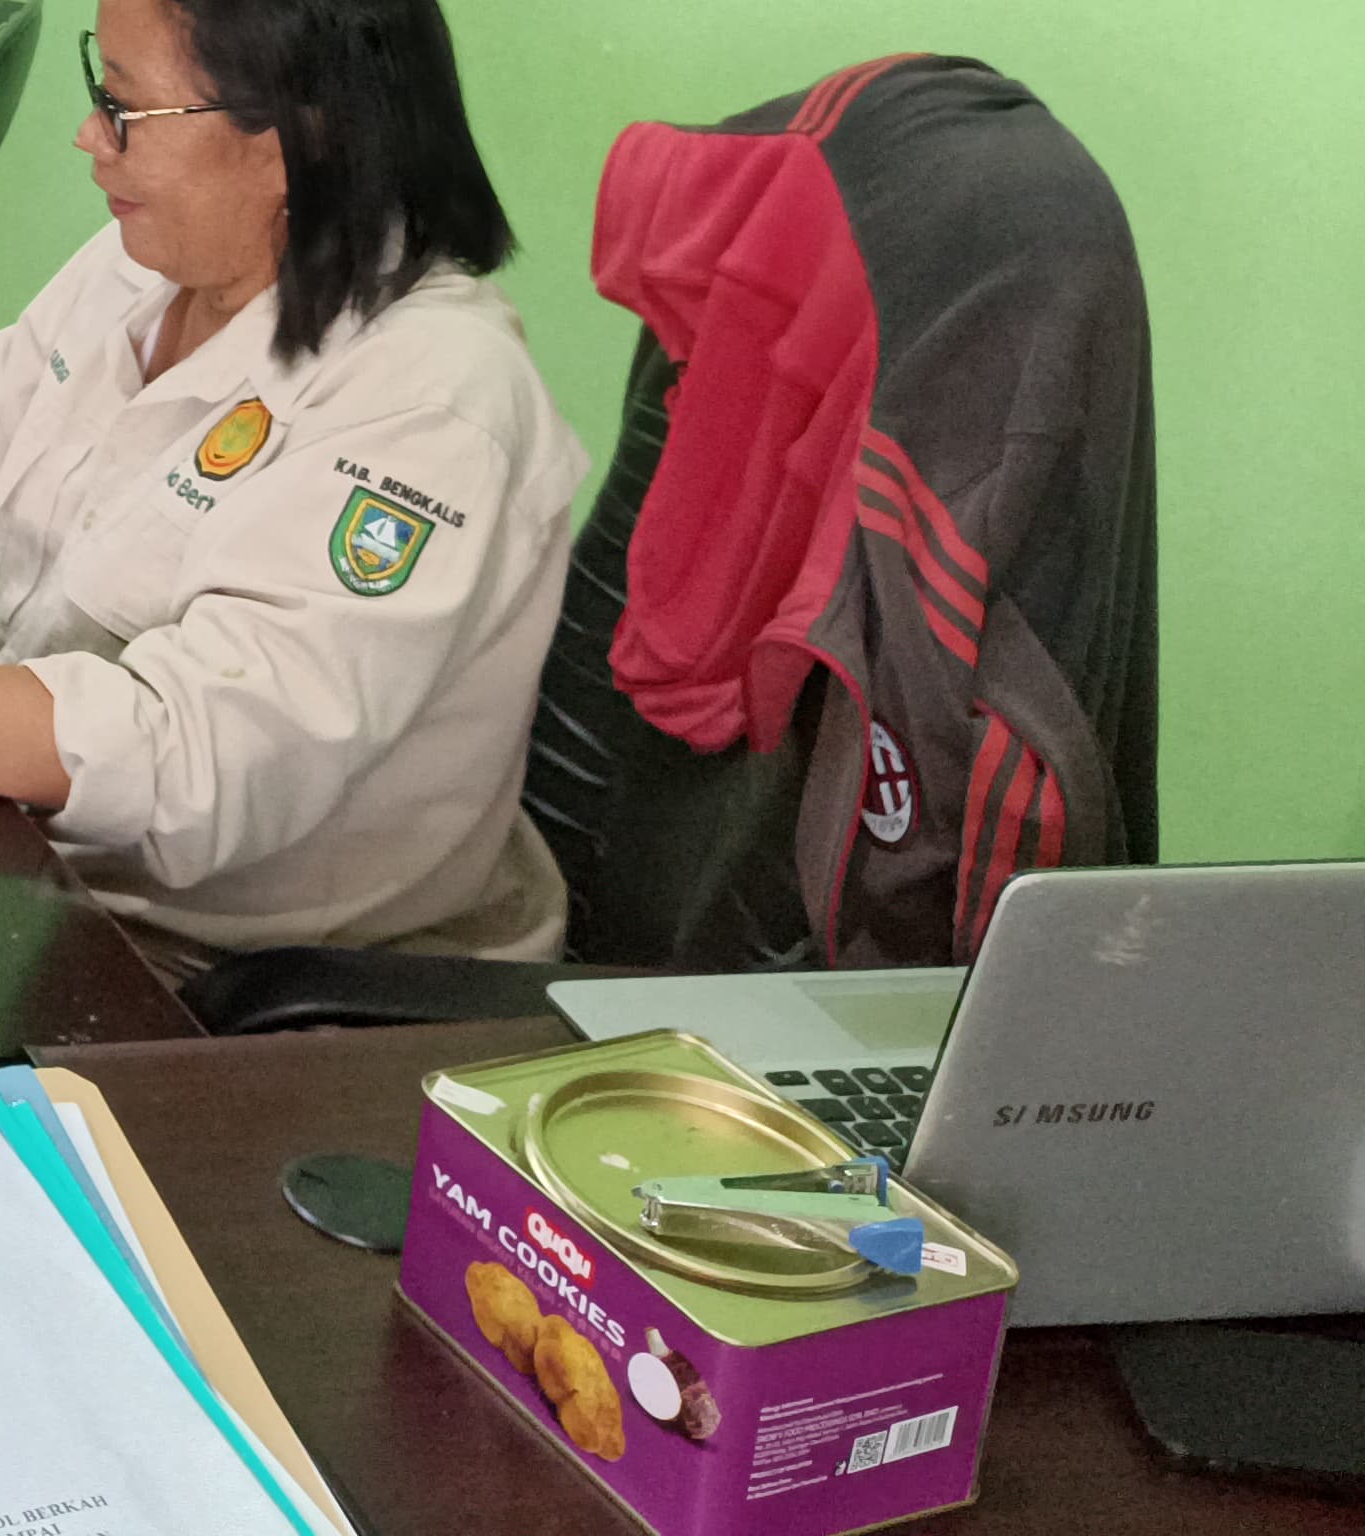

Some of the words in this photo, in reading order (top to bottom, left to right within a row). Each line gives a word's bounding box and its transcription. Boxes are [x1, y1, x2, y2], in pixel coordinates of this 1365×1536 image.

[334, 457, 371, 483] KAB.
[379, 476, 466, 528] BENGKALIS
[432, 1163, 492, 1230] YAM
[498, 1225, 625, 1348] COOKIES
[22, 1495, 108, 1523] BERKAH
